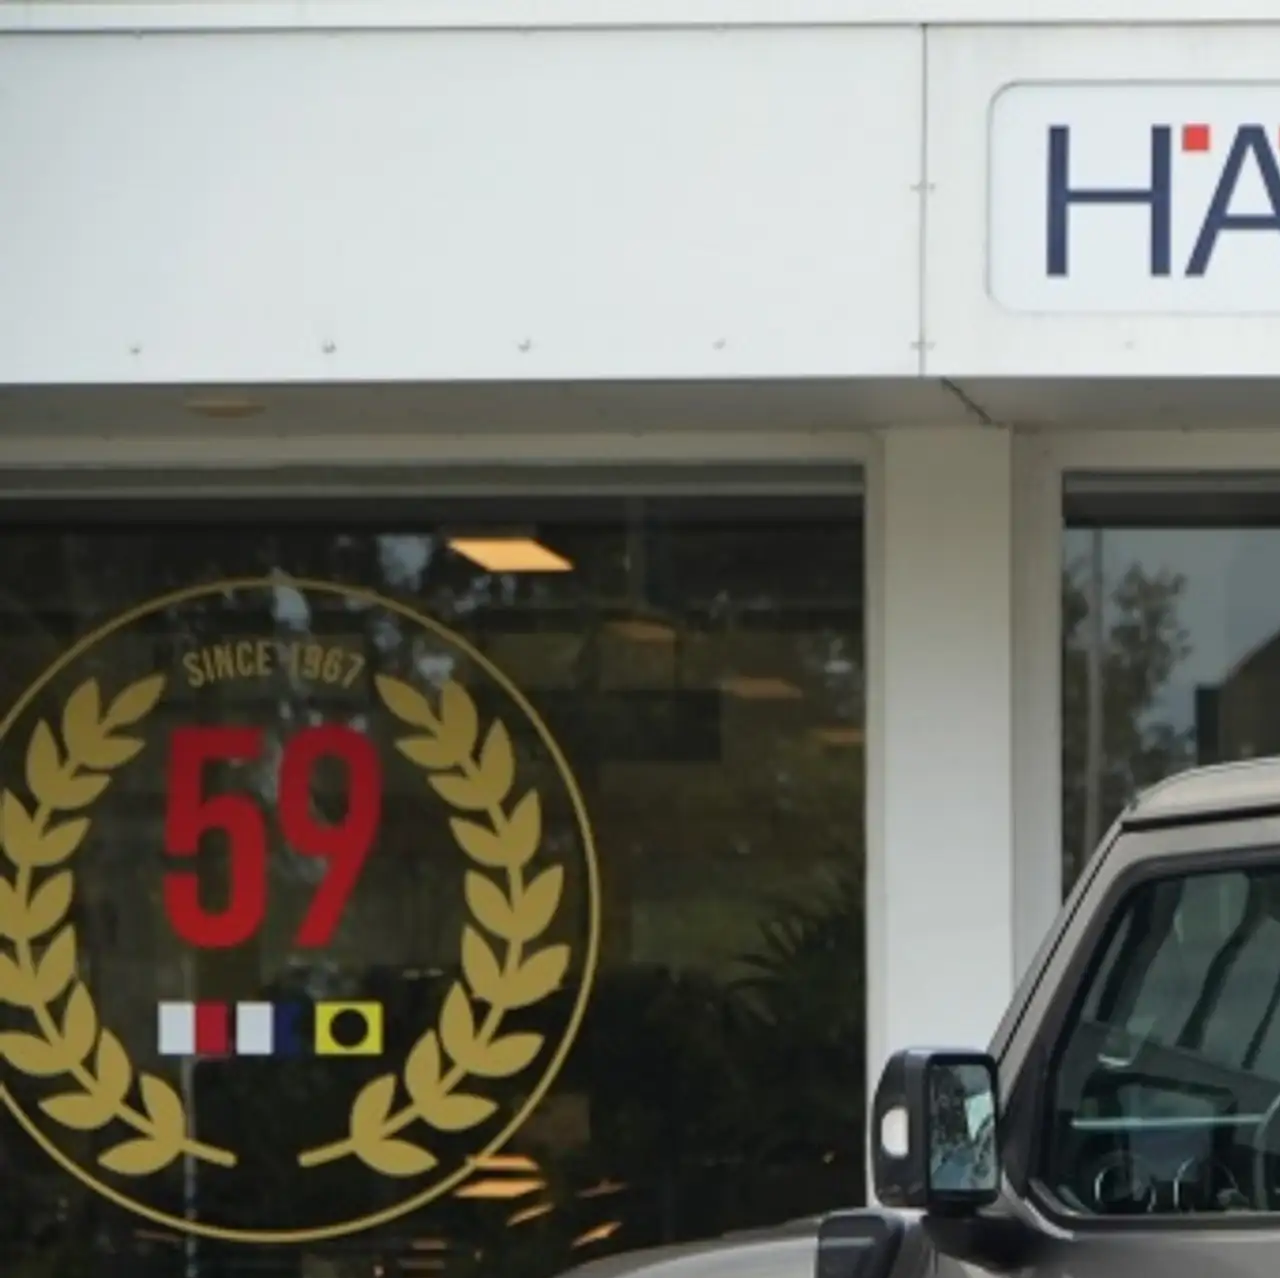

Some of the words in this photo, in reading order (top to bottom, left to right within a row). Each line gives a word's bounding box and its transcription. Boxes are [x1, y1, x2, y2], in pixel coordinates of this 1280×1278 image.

[183, 641, 273, 687] SINCE
[288, 643, 365, 688] 1967
[162, 724, 383, 948] 59
